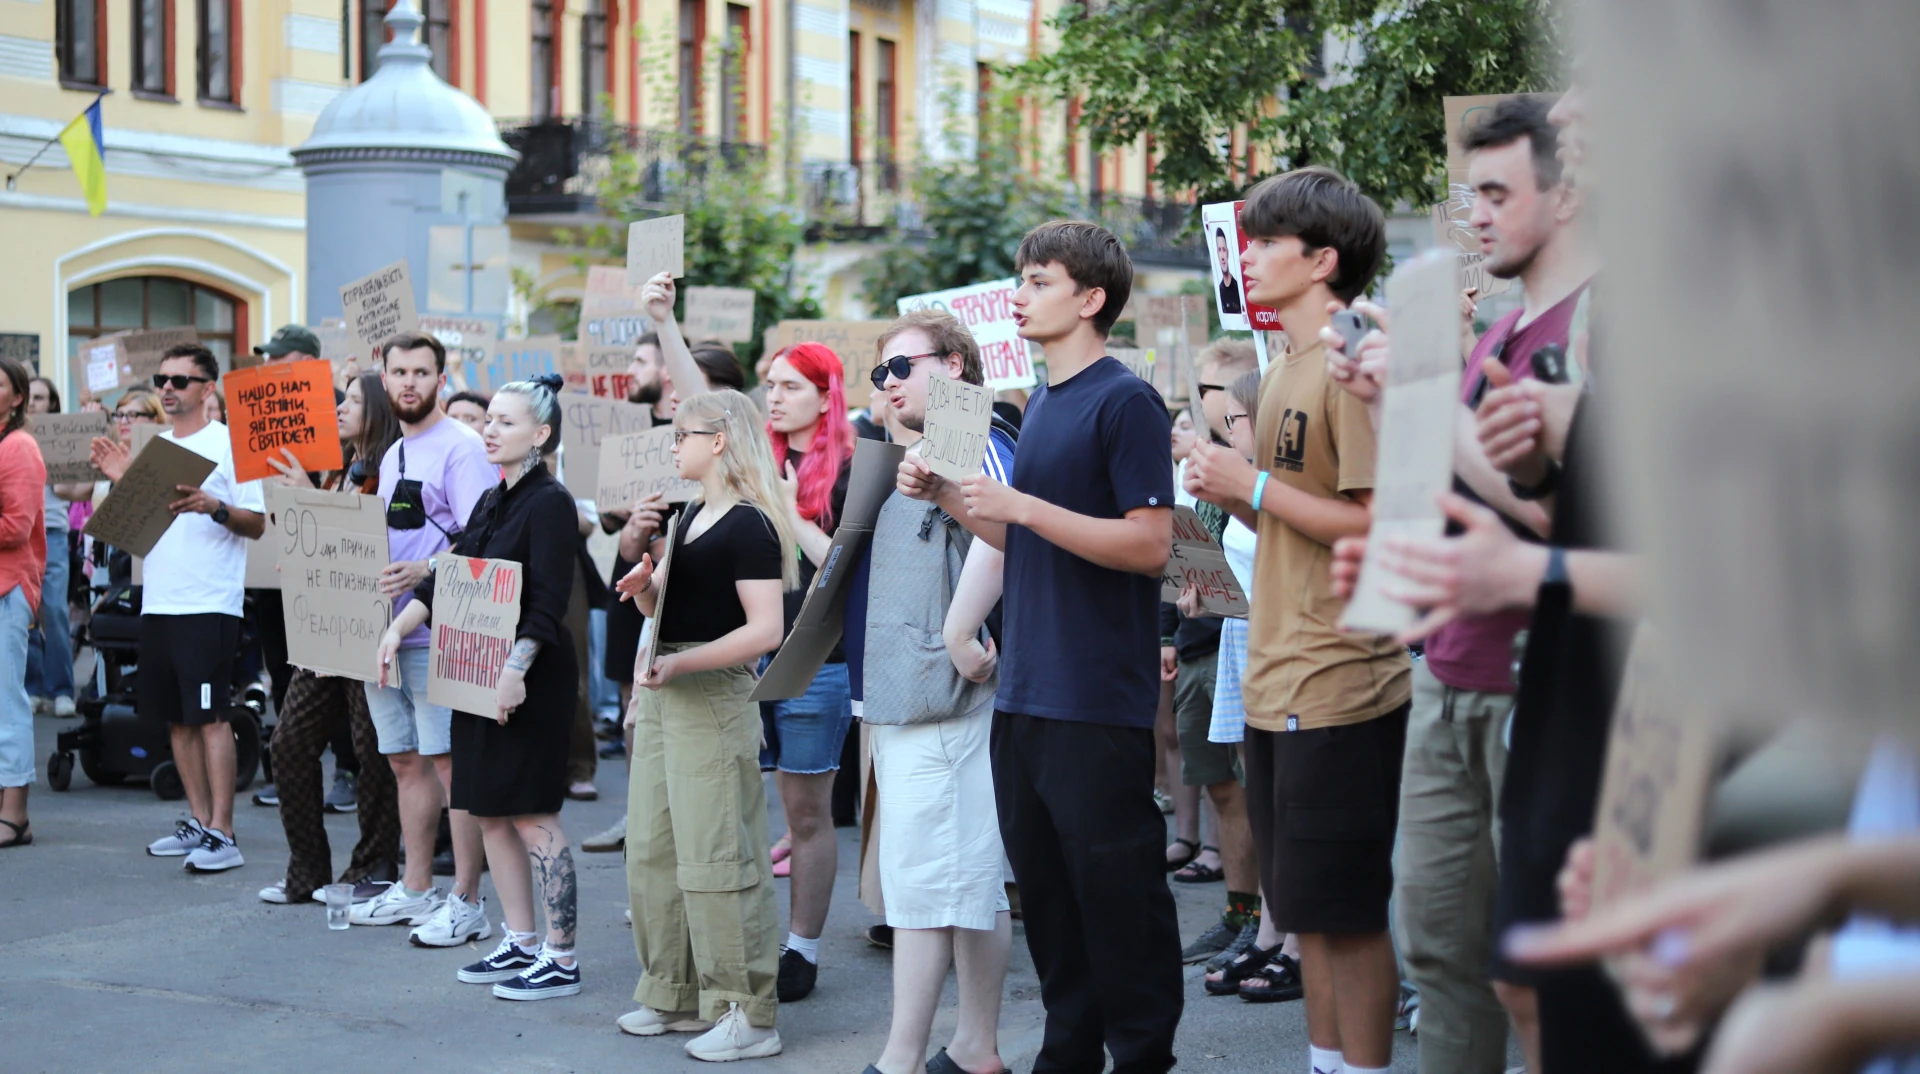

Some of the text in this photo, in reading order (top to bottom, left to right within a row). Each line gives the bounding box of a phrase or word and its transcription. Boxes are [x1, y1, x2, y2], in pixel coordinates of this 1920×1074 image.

[980, 337, 1030, 381] ТЕРАН
[281, 380, 311, 394] НАМ
[955, 385, 970, 412] НЕ
[249, 412, 306, 435] ЯКІ РУСНЯ
[650, 475, 701, 497] ОБОРОН
[284, 508, 317, 557] 90
[341, 538, 376, 559] ПРИЧИН
[306, 568, 386, 595] НЕ ПРИЗНАЧИТ
